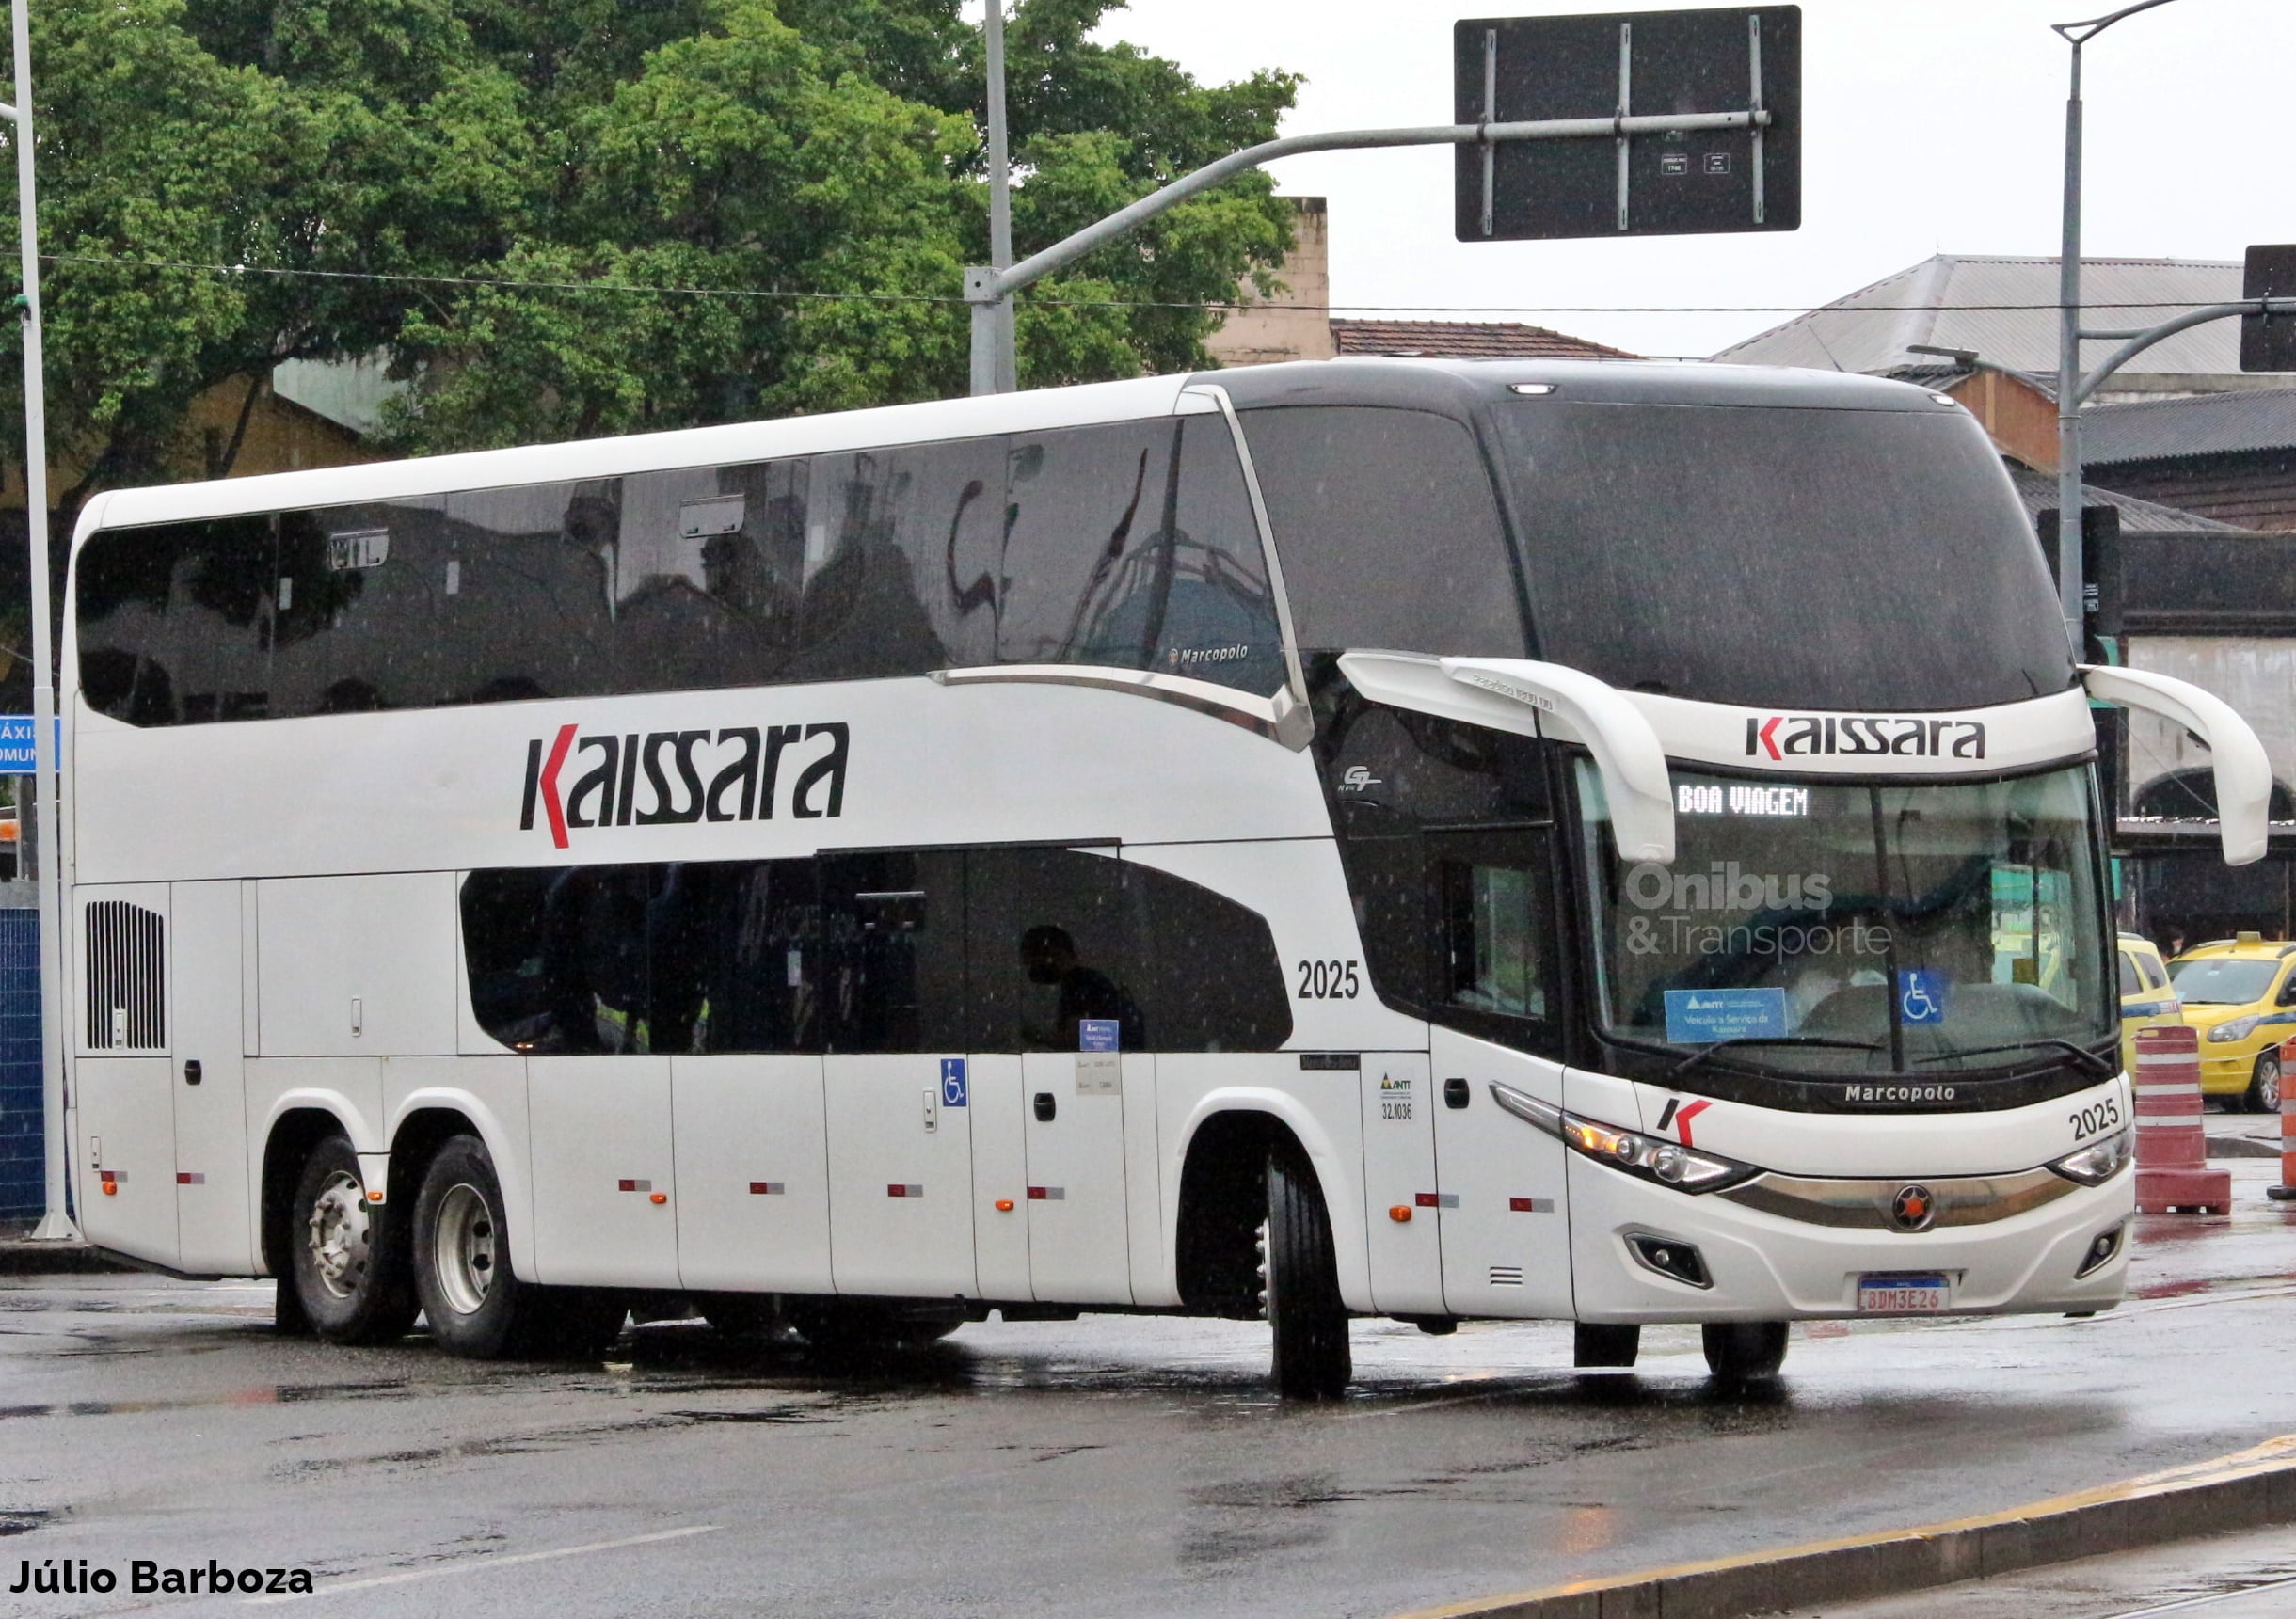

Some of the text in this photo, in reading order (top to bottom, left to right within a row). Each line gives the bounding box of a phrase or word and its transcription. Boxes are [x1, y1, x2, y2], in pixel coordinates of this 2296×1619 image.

[1181, 643, 1248, 663] Marcopolo
[0, 722, 35, 739] ÁXI
[0, 748, 36, 761] MU
[1678, 785, 1808, 816] BOA VIAGEM
[1298, 960, 1359, 999] 2025
[1393, 1080, 1411, 1090] ANTT
[1845, 1085, 1955, 1102] Marcopolo
[2069, 1098, 2119, 1141] 2025
